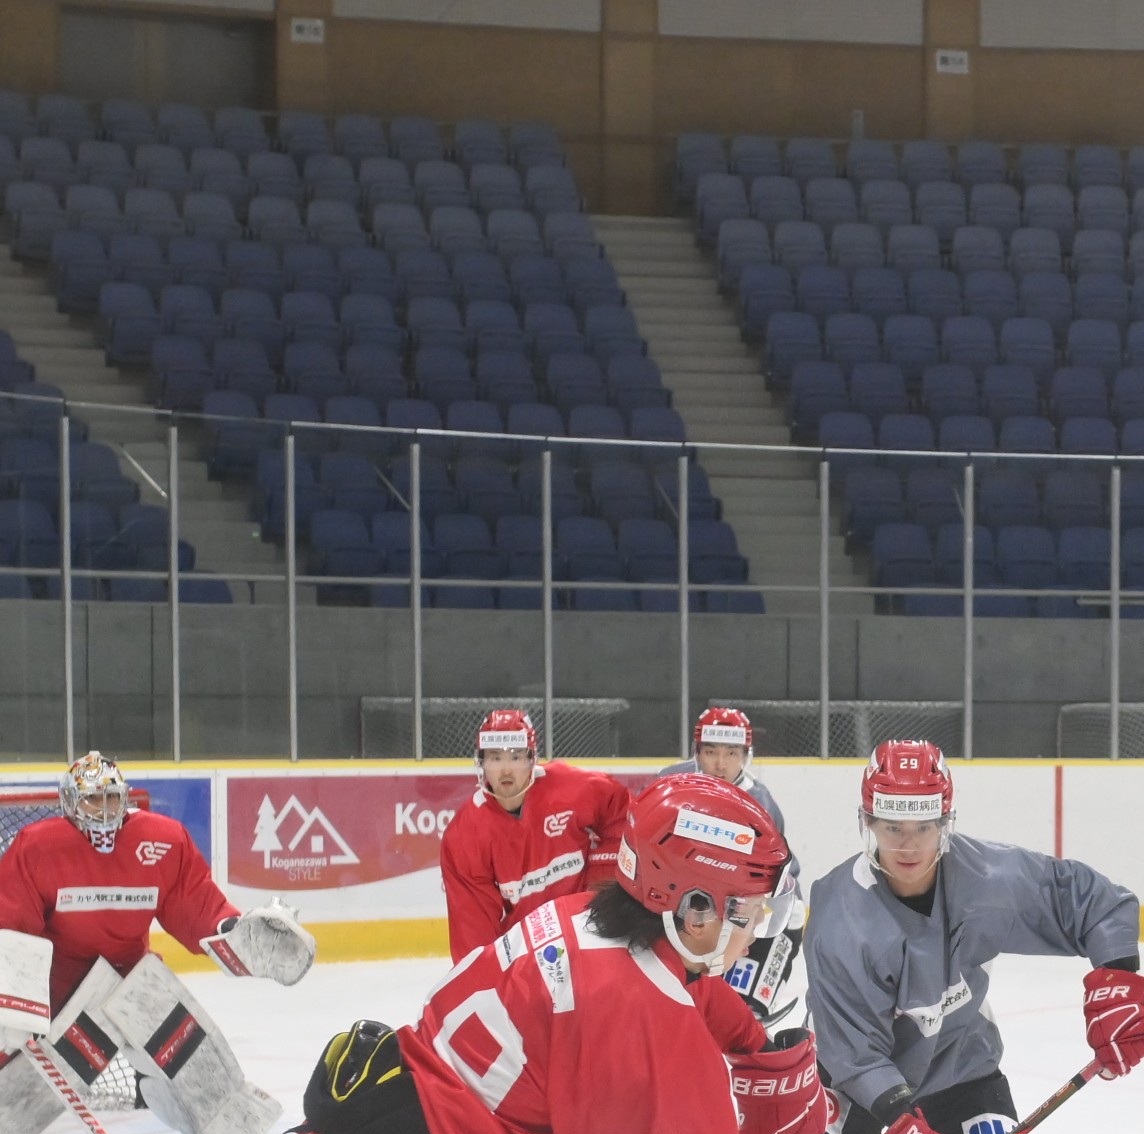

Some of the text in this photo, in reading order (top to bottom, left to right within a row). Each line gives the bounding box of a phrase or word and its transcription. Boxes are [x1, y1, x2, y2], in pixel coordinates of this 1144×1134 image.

[899, 758, 918, 769] 29
[874, 798, 940, 812] 札幌道都病院
[92, 829, 115, 848] 35
[271, 856, 327, 870] Koganezawa
[288, 868, 322, 881] STYLE
